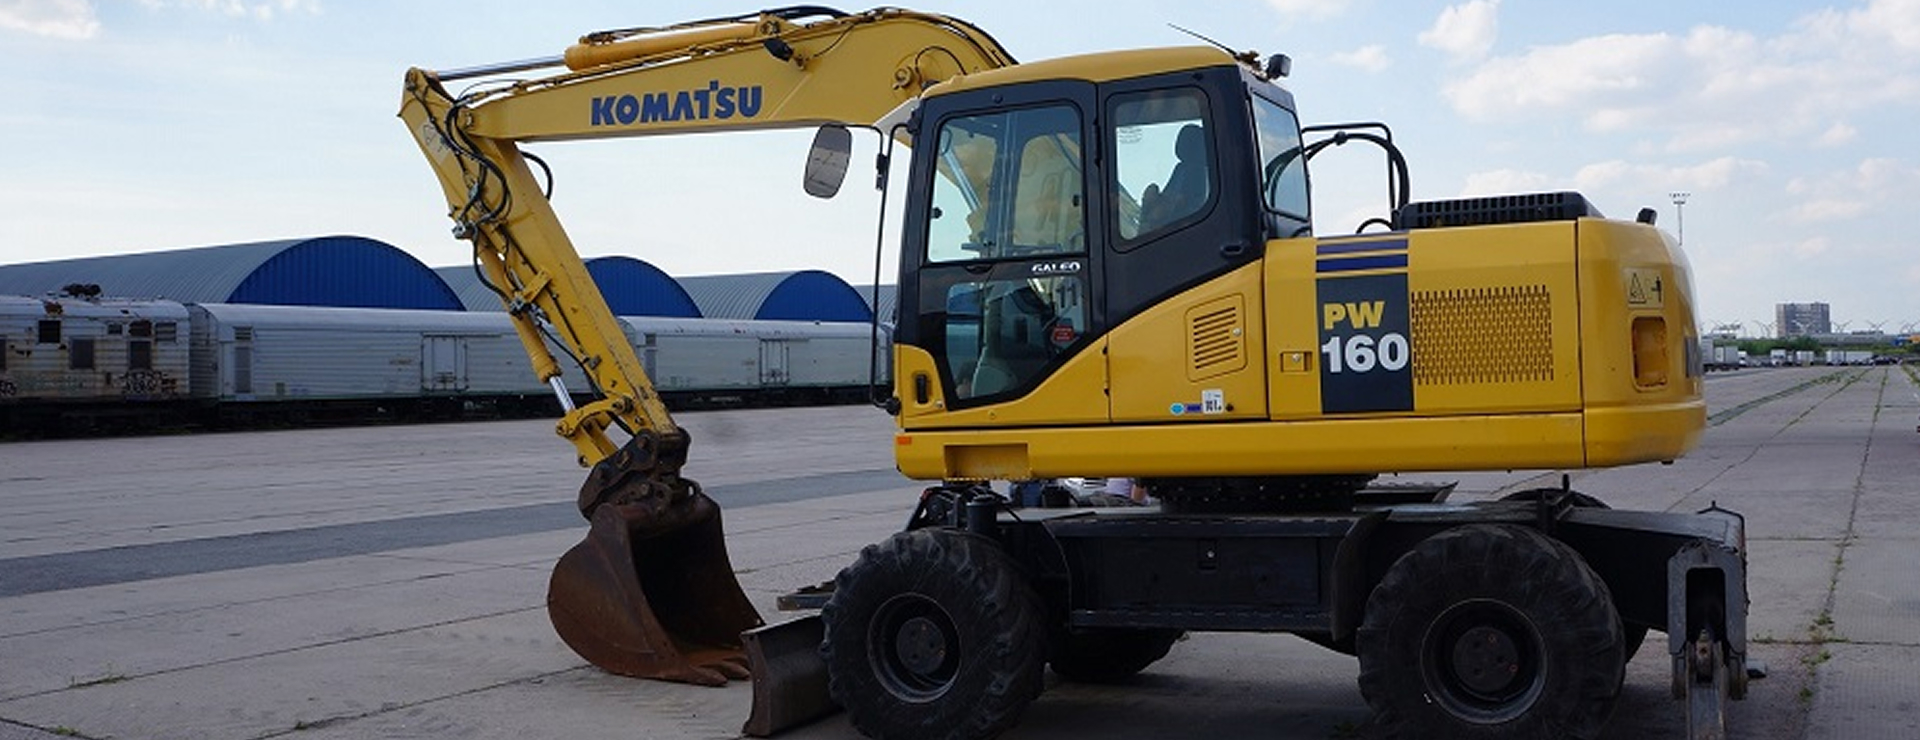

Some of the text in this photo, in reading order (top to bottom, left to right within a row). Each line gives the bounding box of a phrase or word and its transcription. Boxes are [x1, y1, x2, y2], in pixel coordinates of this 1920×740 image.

[591, 80, 762, 125] KOMATSU
[1324, 301, 1385, 330] PW
[1322, 333, 1409, 373] 160
